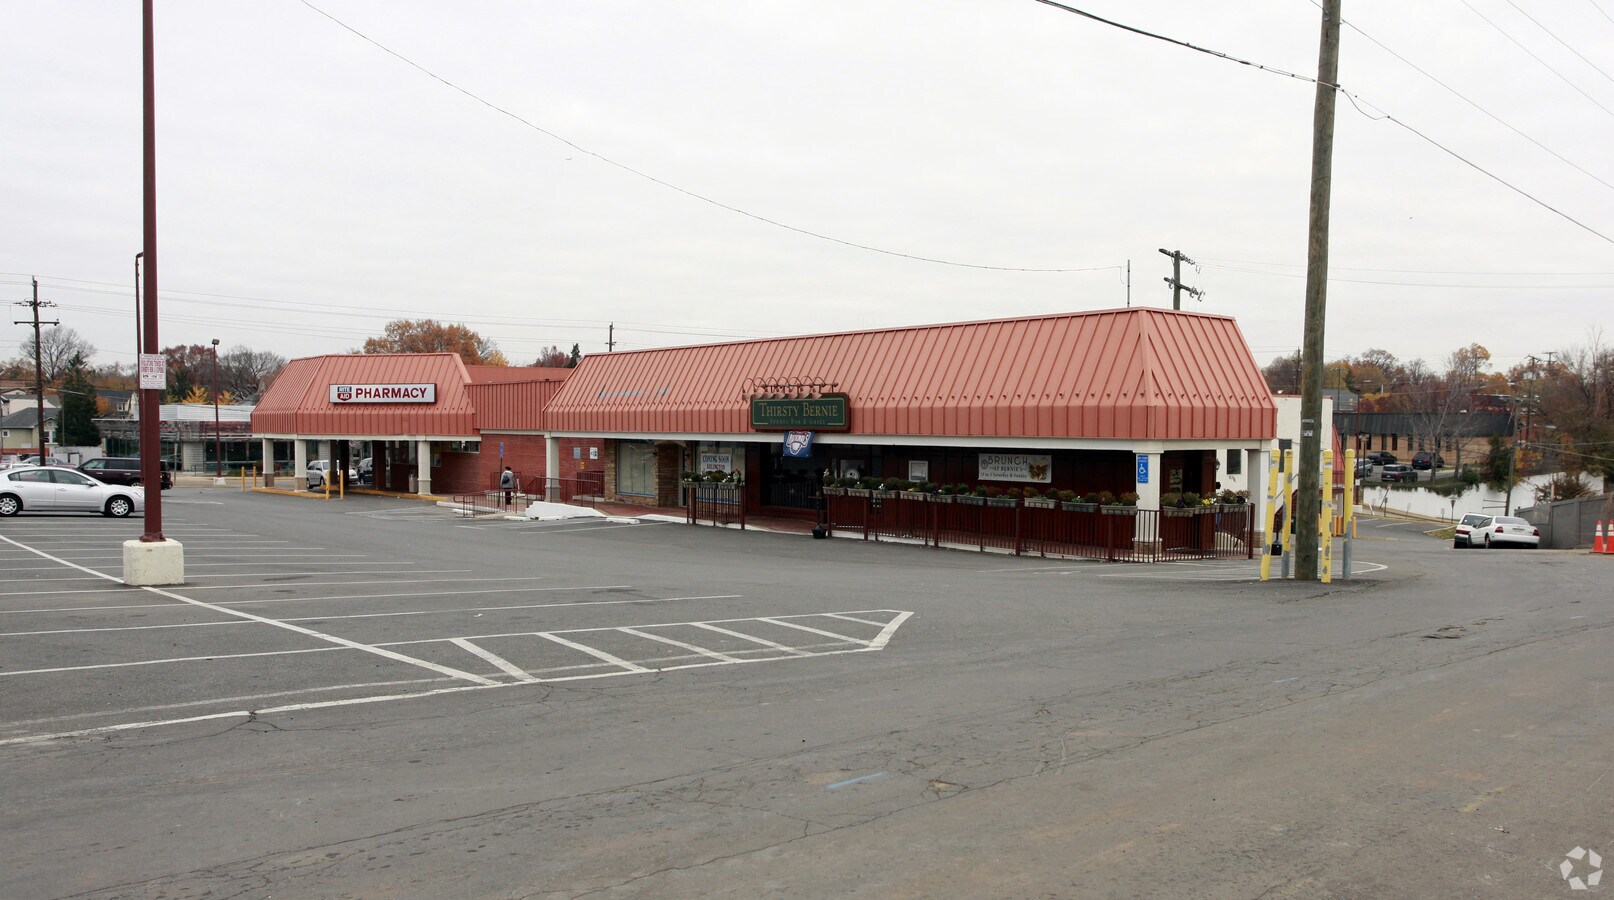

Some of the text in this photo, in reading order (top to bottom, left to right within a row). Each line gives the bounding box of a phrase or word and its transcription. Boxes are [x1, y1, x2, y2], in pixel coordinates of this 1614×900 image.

[355, 387, 427, 399] PHARMACY
[759, 402, 838, 417] THIRSTY BERNIE
[702, 455, 730, 463] COMING SOON
[988, 455, 1028, 466] BRUNCH
